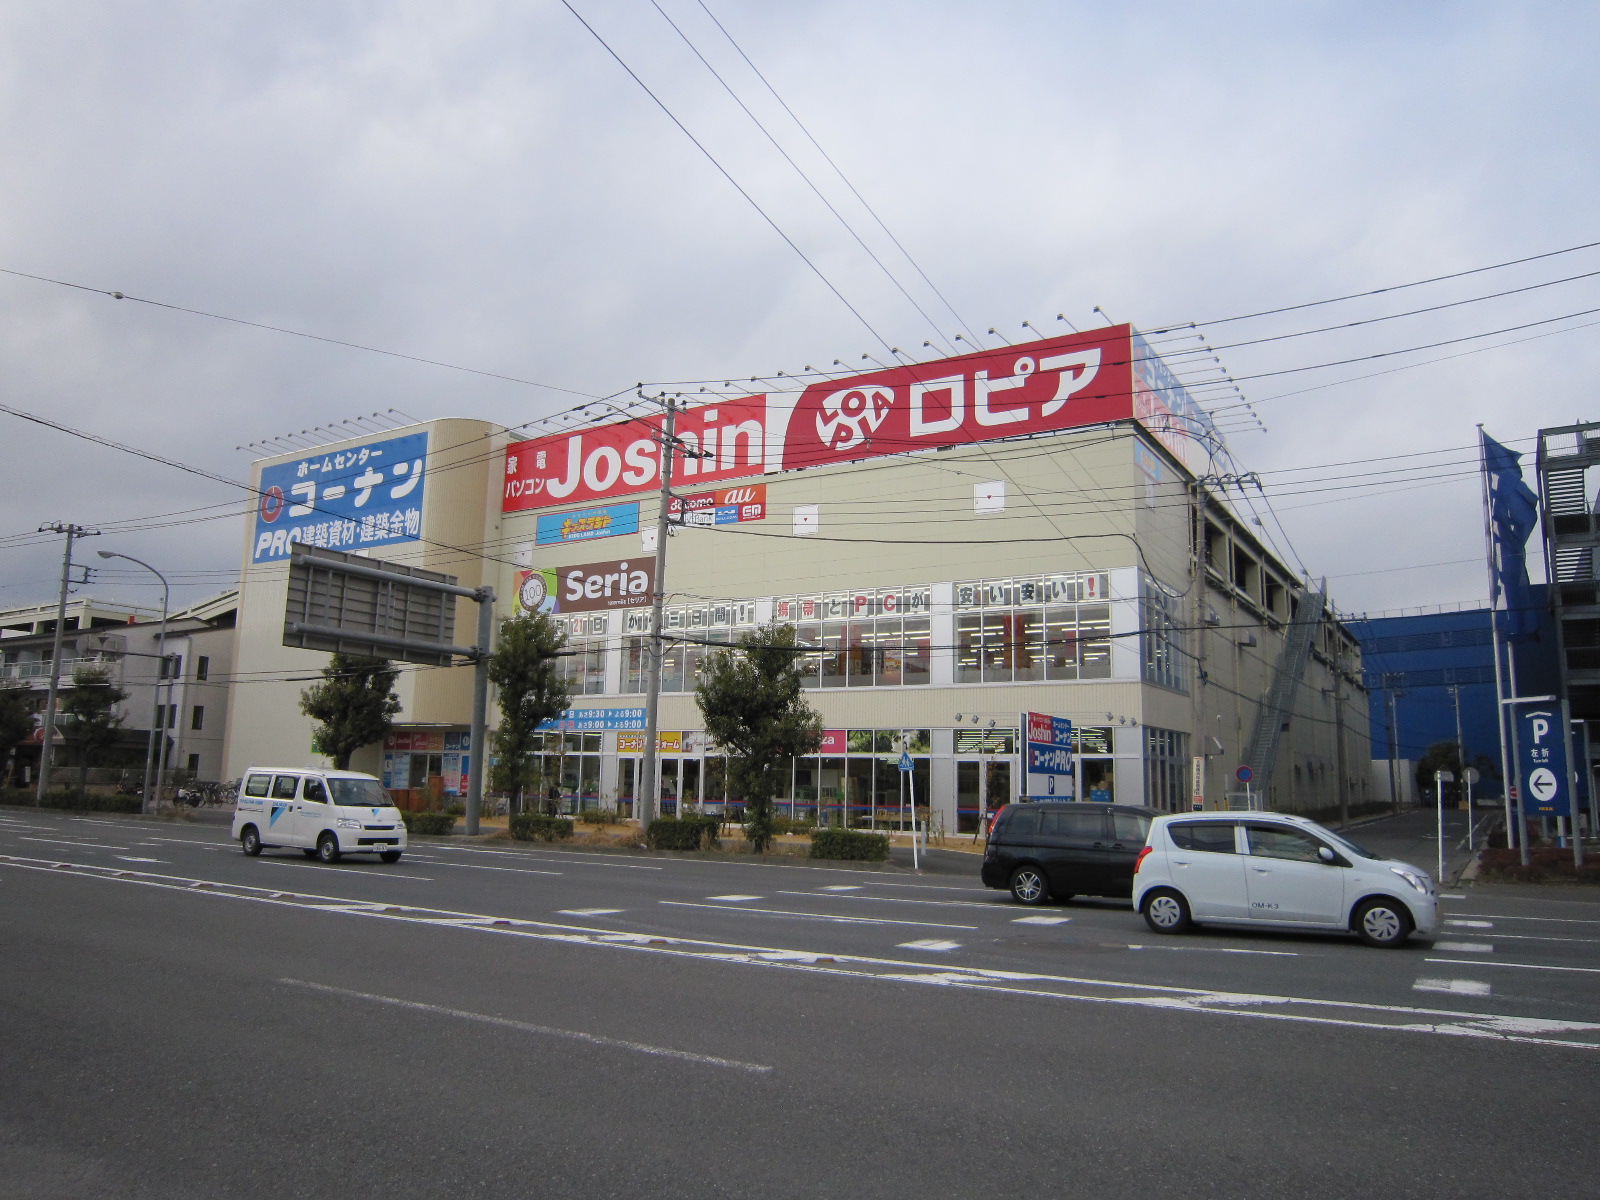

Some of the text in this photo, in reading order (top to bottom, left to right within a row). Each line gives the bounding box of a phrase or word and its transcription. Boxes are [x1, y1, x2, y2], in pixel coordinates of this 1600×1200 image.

[909, 347, 1102, 438] ロピア
[296, 447, 383, 478] ホームセンター
[546, 408, 764, 499] Joshin
[289, 458, 423, 517] コーナン
[505, 476, 547, 499] パソコン
[724, 487, 757, 505] au
[566, 561, 649, 601] Seria
[1533, 718, 1549, 744] P
[1530, 747, 1550, 758] 左折
